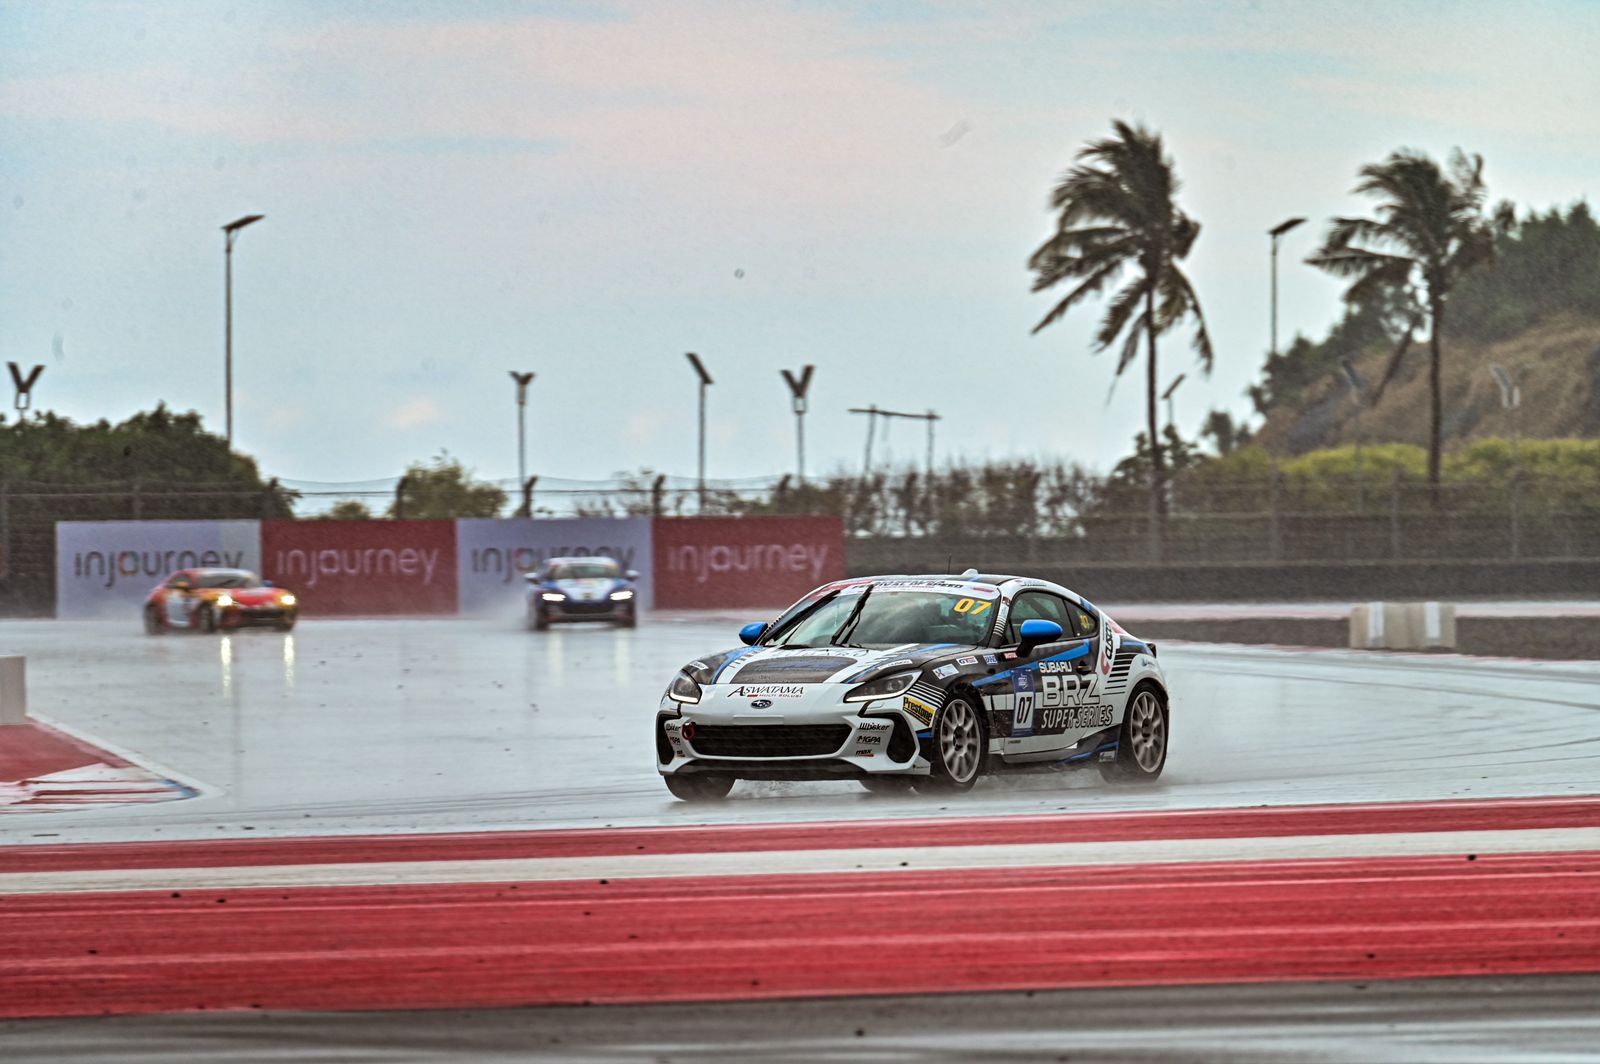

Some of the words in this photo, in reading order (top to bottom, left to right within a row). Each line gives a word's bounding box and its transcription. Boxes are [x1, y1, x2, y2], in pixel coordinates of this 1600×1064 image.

[276, 547, 439, 587] injourney
[668, 543, 829, 583] injourney
[953, 598, 993, 615] 07
[1038, 661, 1073, 674] SUBARU
[727, 685, 806, 698] ASWATAMA
[1041, 672, 1100, 707] BRZ
[903, 696, 934, 721] Prestone
[1016, 696, 1033, 724] 07
[1041, 707, 1076, 729] SUPER
[1075, 704, 1114, 729] SERIES
[857, 735, 881, 743] MGPA
